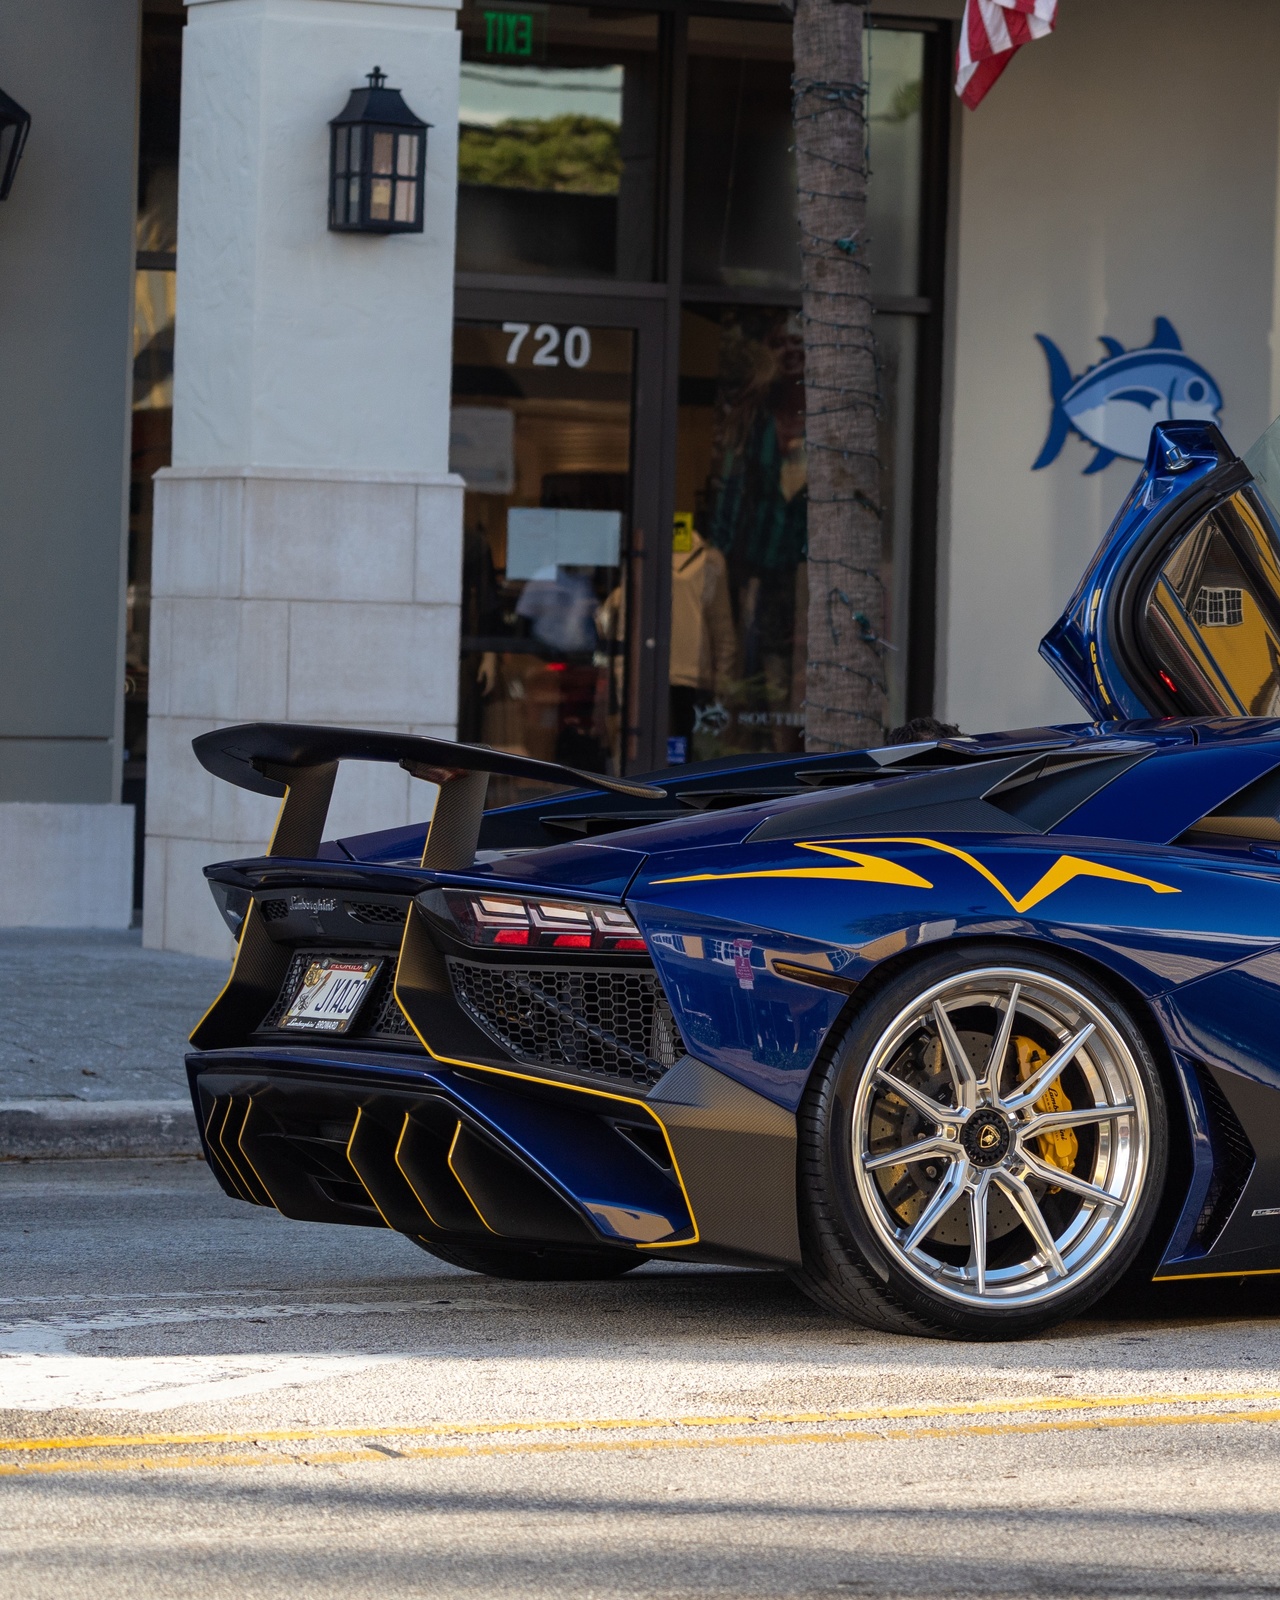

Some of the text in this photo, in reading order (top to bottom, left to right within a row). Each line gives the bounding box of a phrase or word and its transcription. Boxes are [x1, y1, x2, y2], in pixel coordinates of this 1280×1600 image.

[502, 322, 591, 368] 720
[290, 895, 338, 914] Lamborghini
[314, 979, 368, 1013] JYACO
[1048, 1087, 1068, 1141] Lambini
